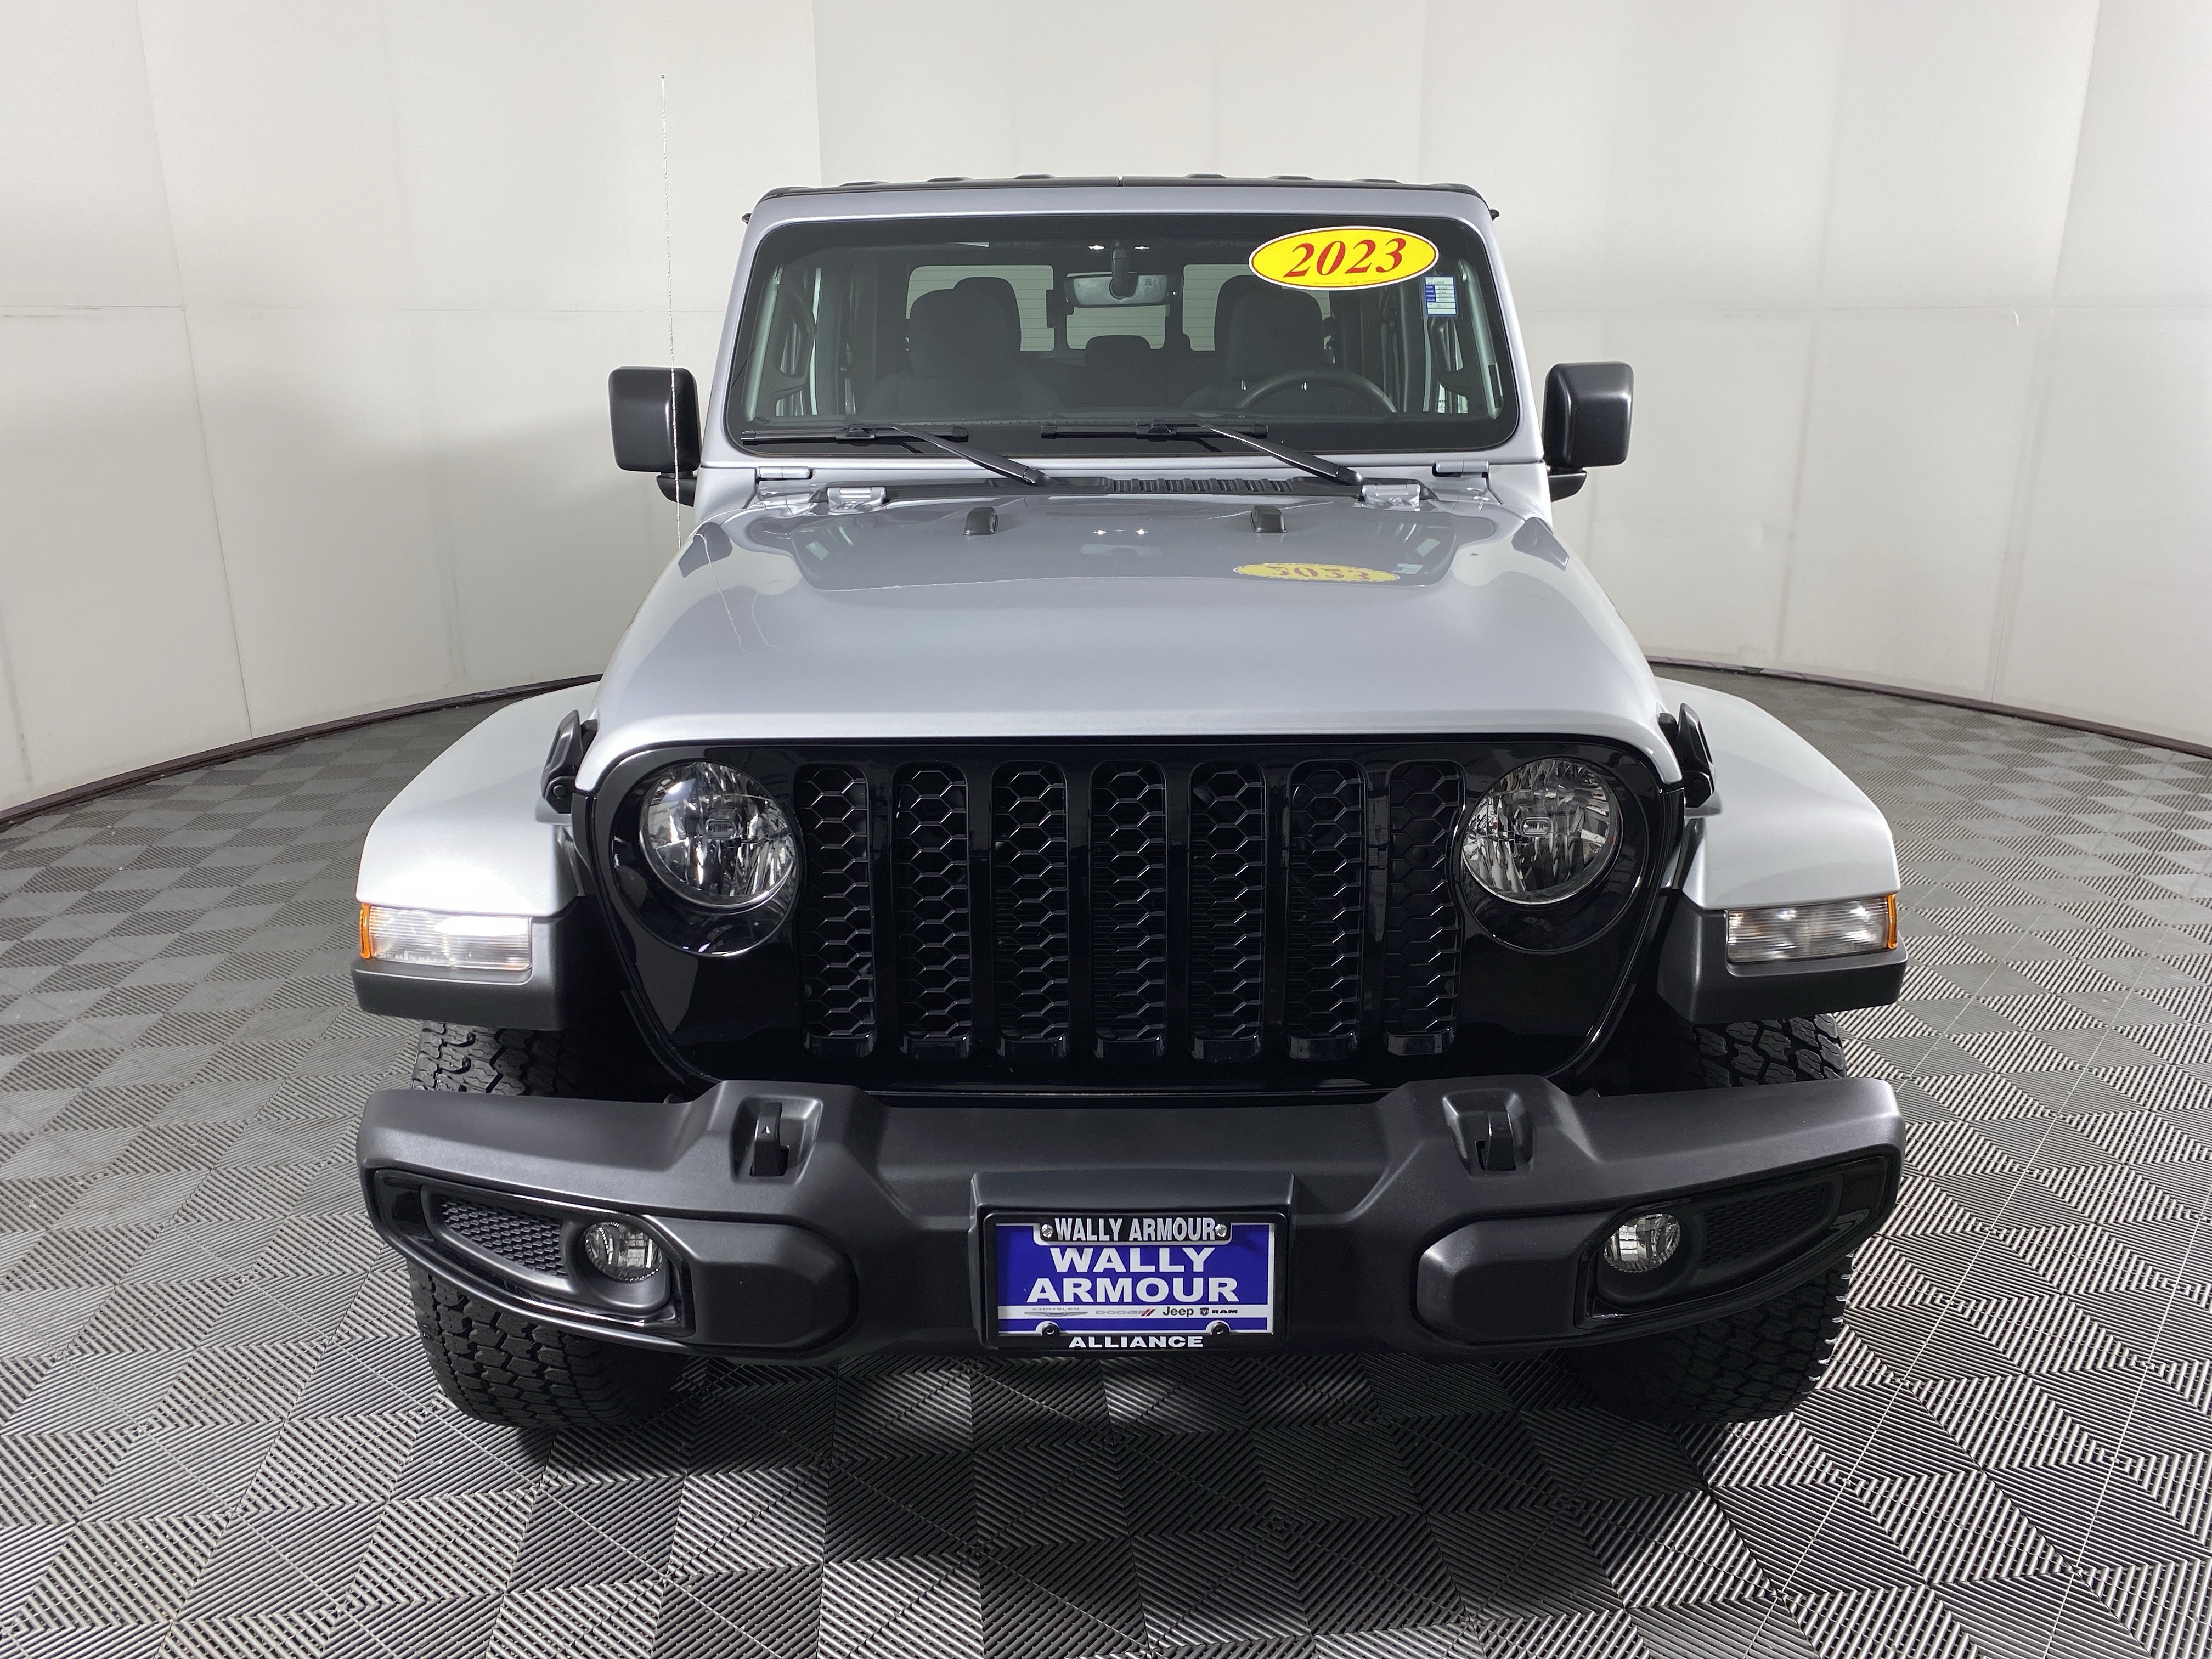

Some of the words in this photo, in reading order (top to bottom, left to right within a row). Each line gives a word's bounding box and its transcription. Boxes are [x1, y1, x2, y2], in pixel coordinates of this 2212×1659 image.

[1283, 238, 1406, 278] 2023
[1054, 1217, 1123, 1241] WALLY
[1128, 1217, 1215, 1241] ARMOUR
[1050, 1248, 1215, 1272] WALLY
[1026, 1277, 1239, 1302] ARMOUR
[1163, 1306, 1194, 1317] Jeep
[1069, 1336, 1203, 1348] ALLIANCE
